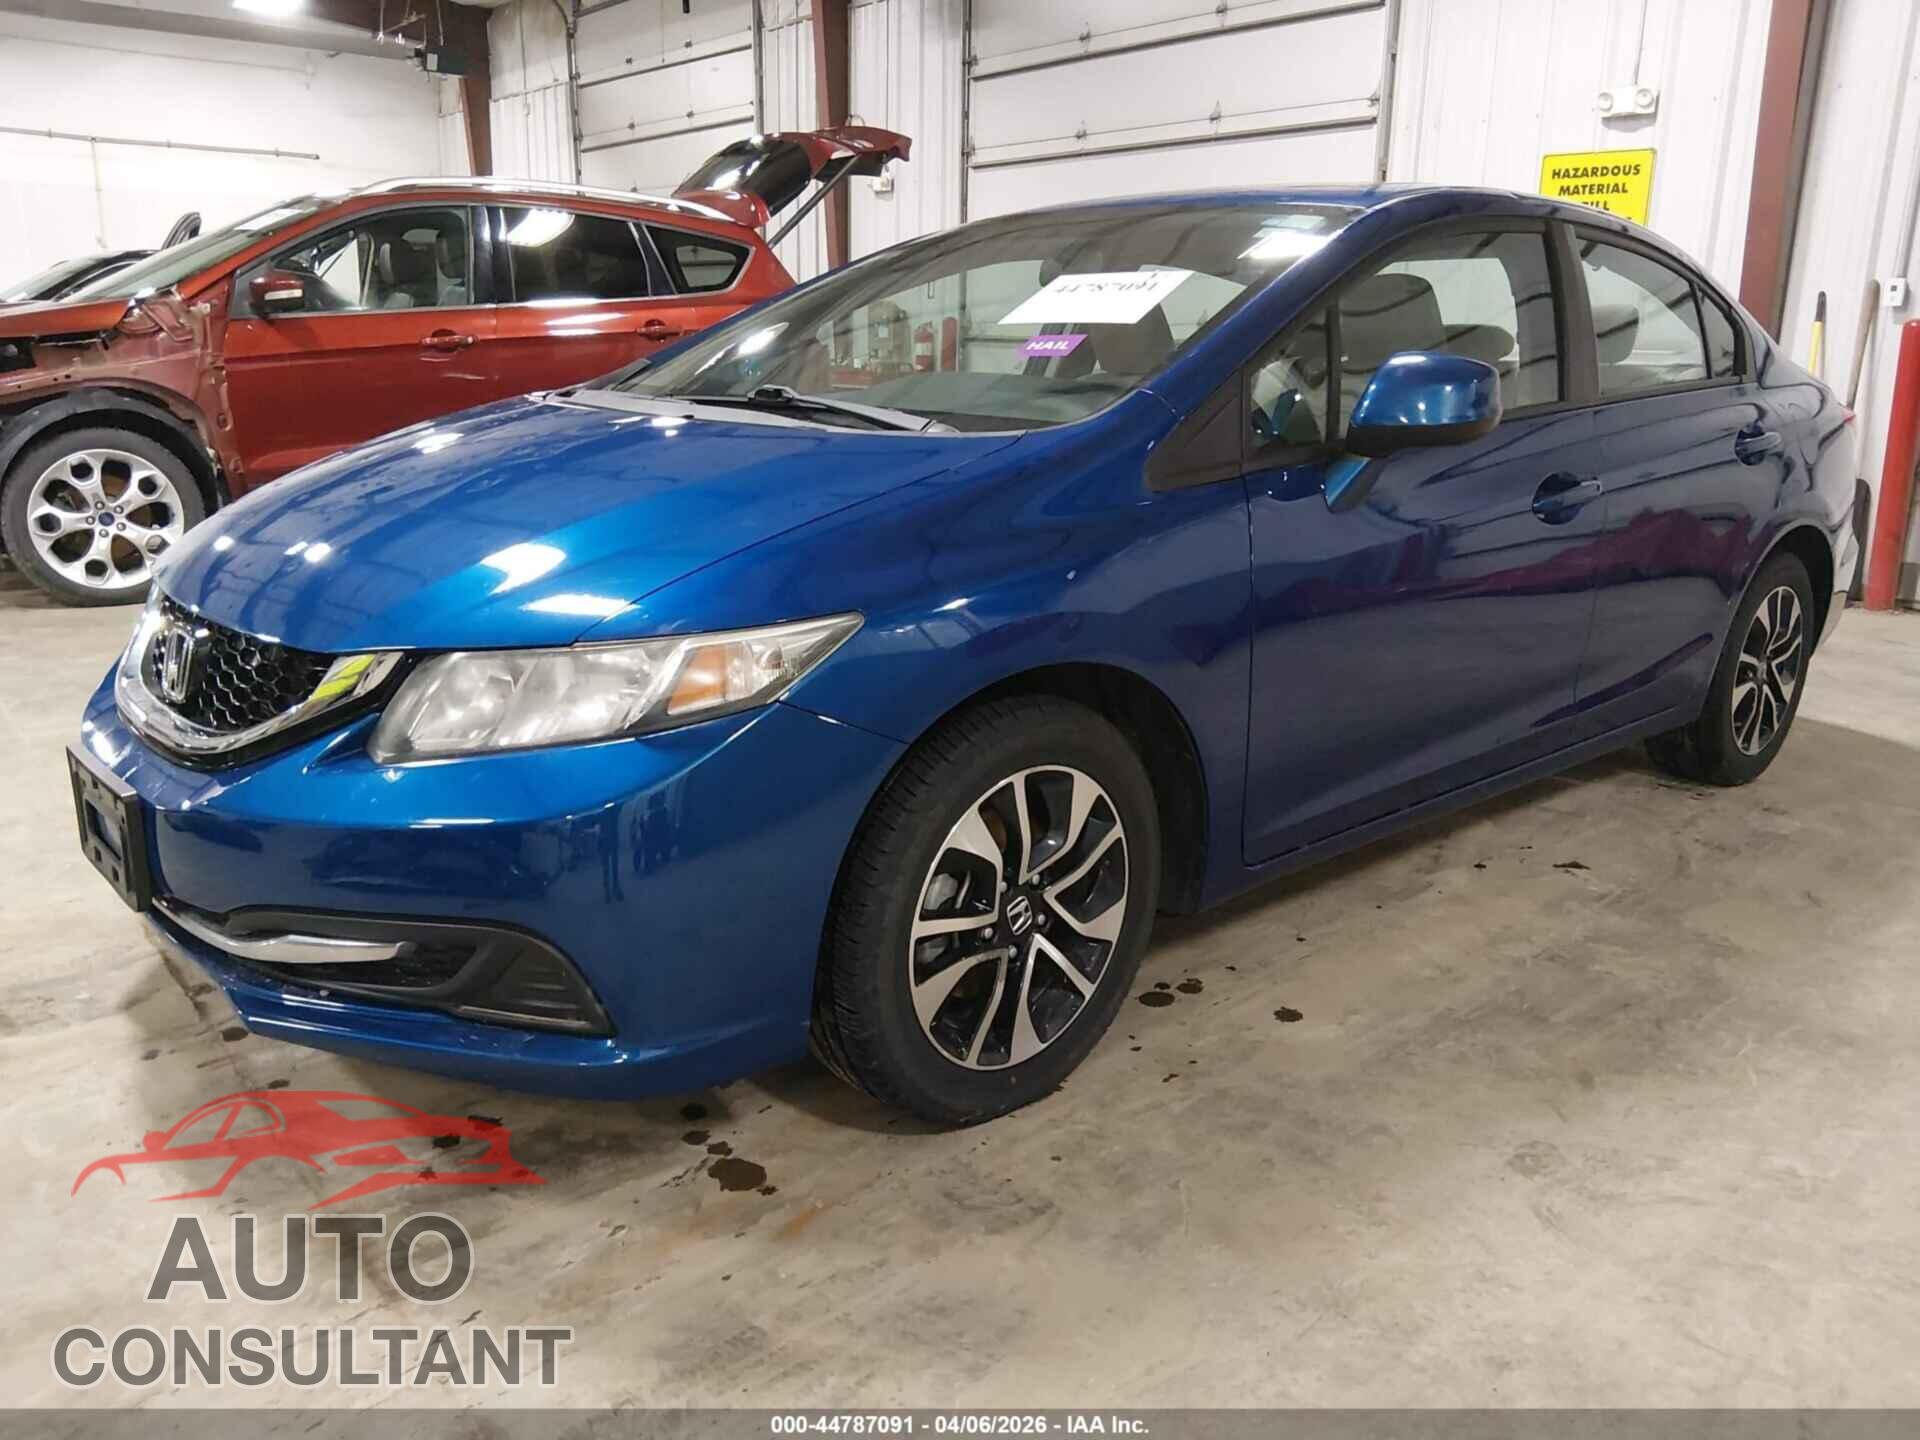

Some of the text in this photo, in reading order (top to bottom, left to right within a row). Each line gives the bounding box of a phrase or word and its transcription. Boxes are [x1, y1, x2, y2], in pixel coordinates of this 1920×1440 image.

[1552, 164, 1640, 179] HAZARDOUS
[1558, 183, 1629, 197] MATERIAL
[1025, 340, 1069, 351] HAIL
